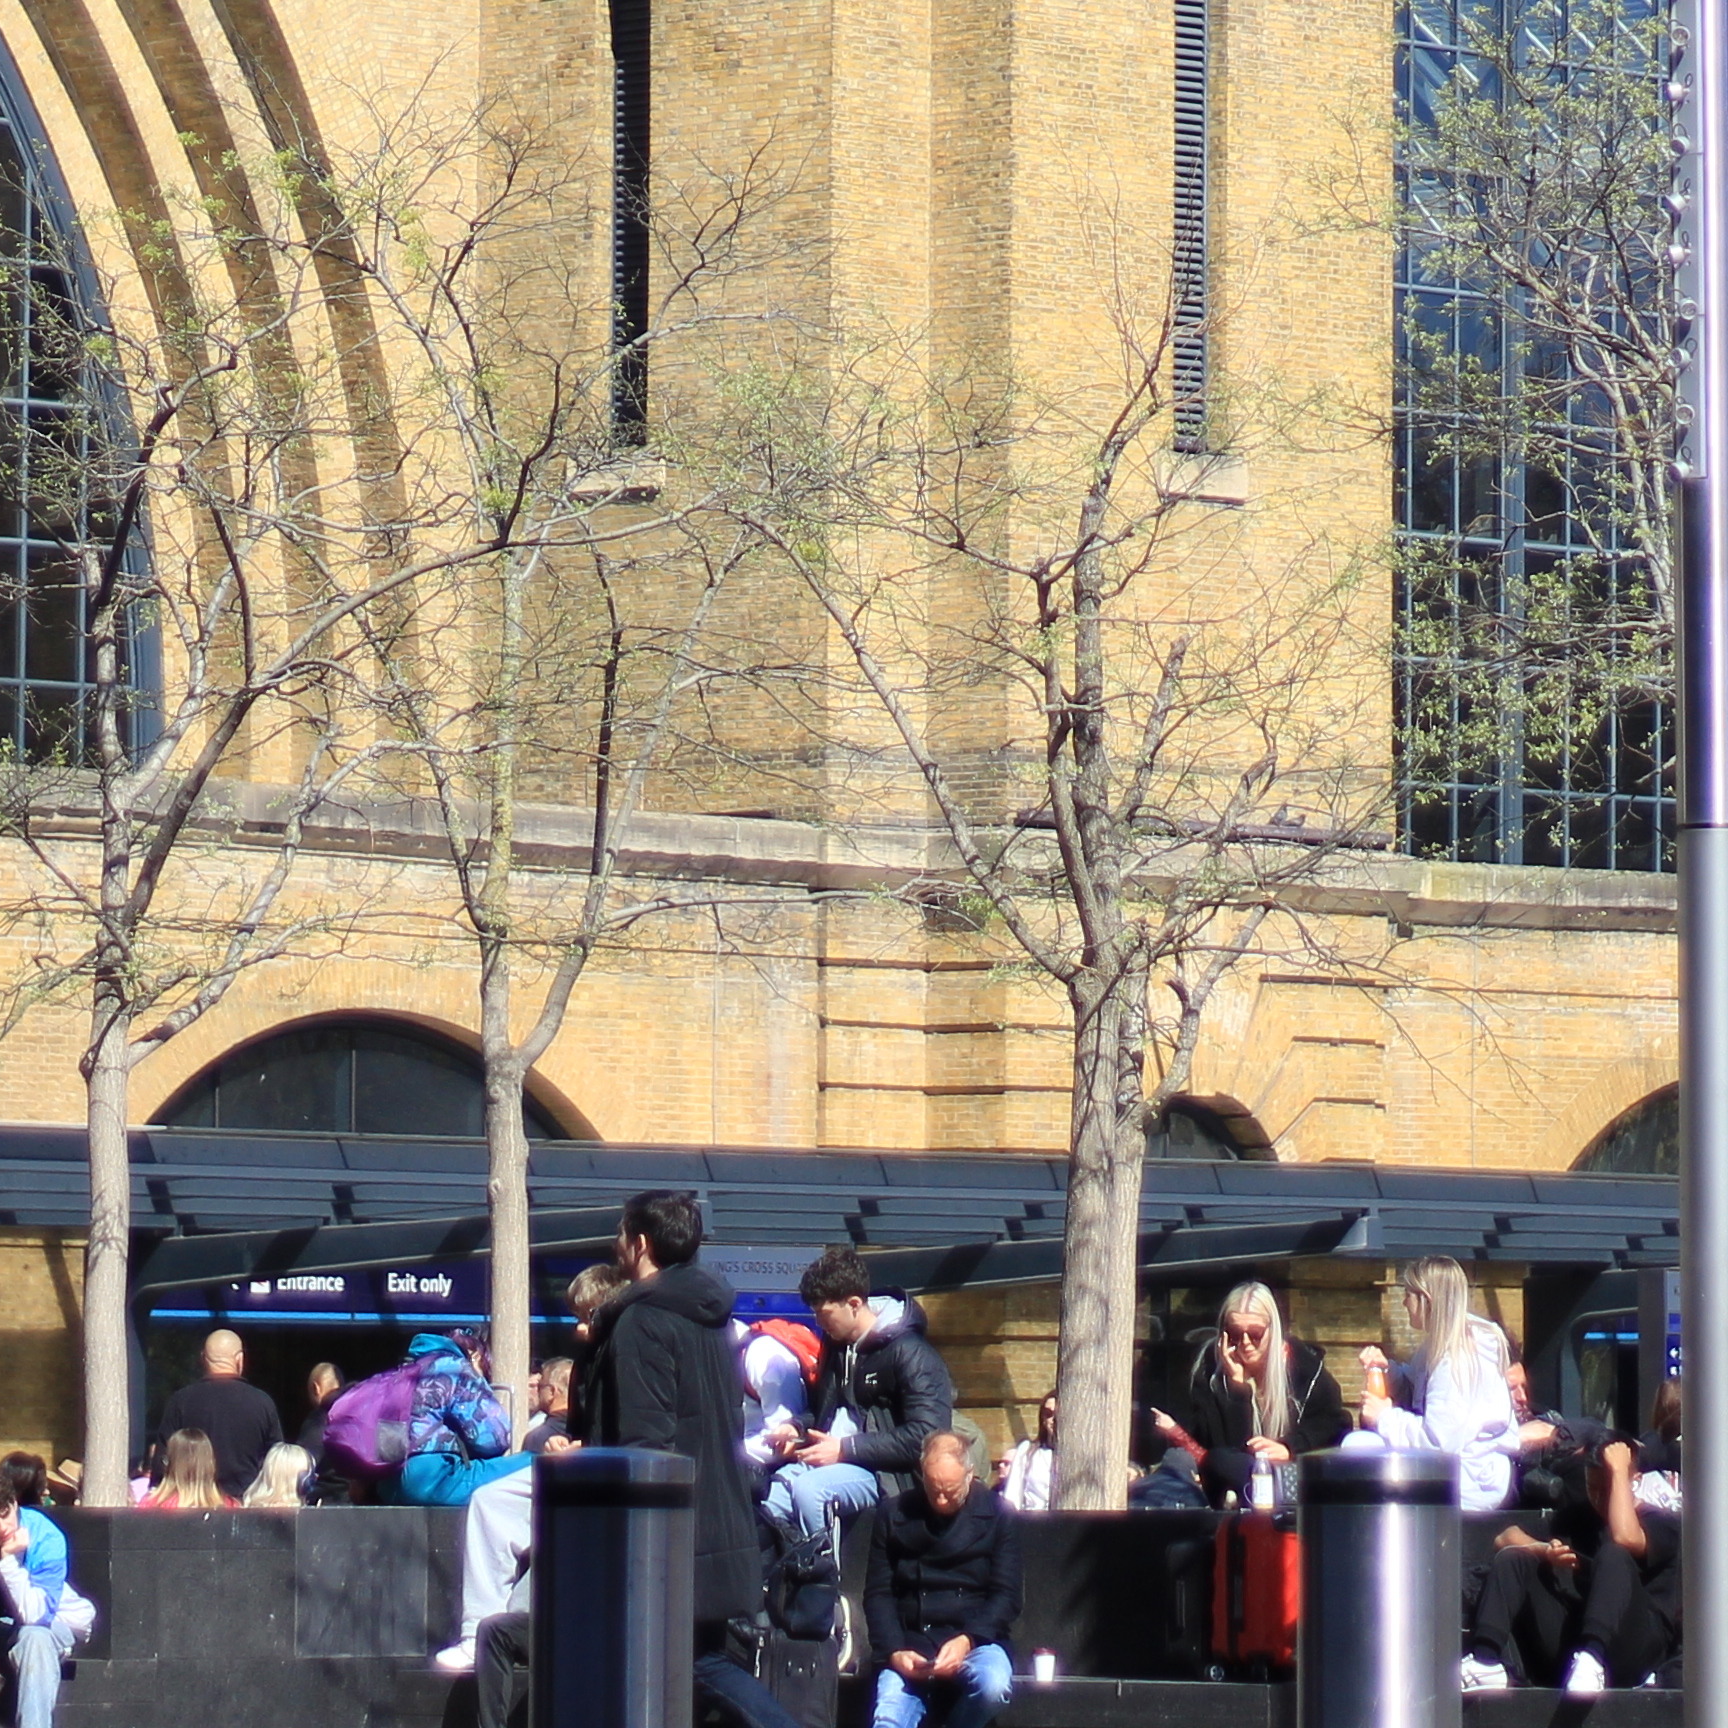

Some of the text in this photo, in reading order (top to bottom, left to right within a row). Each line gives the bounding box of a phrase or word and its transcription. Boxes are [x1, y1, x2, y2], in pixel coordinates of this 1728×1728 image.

[741, 1260, 773, 1274] CROSS
[277, 1275, 345, 1292] Entrance
[387, 1272, 452, 1298] Exit only
